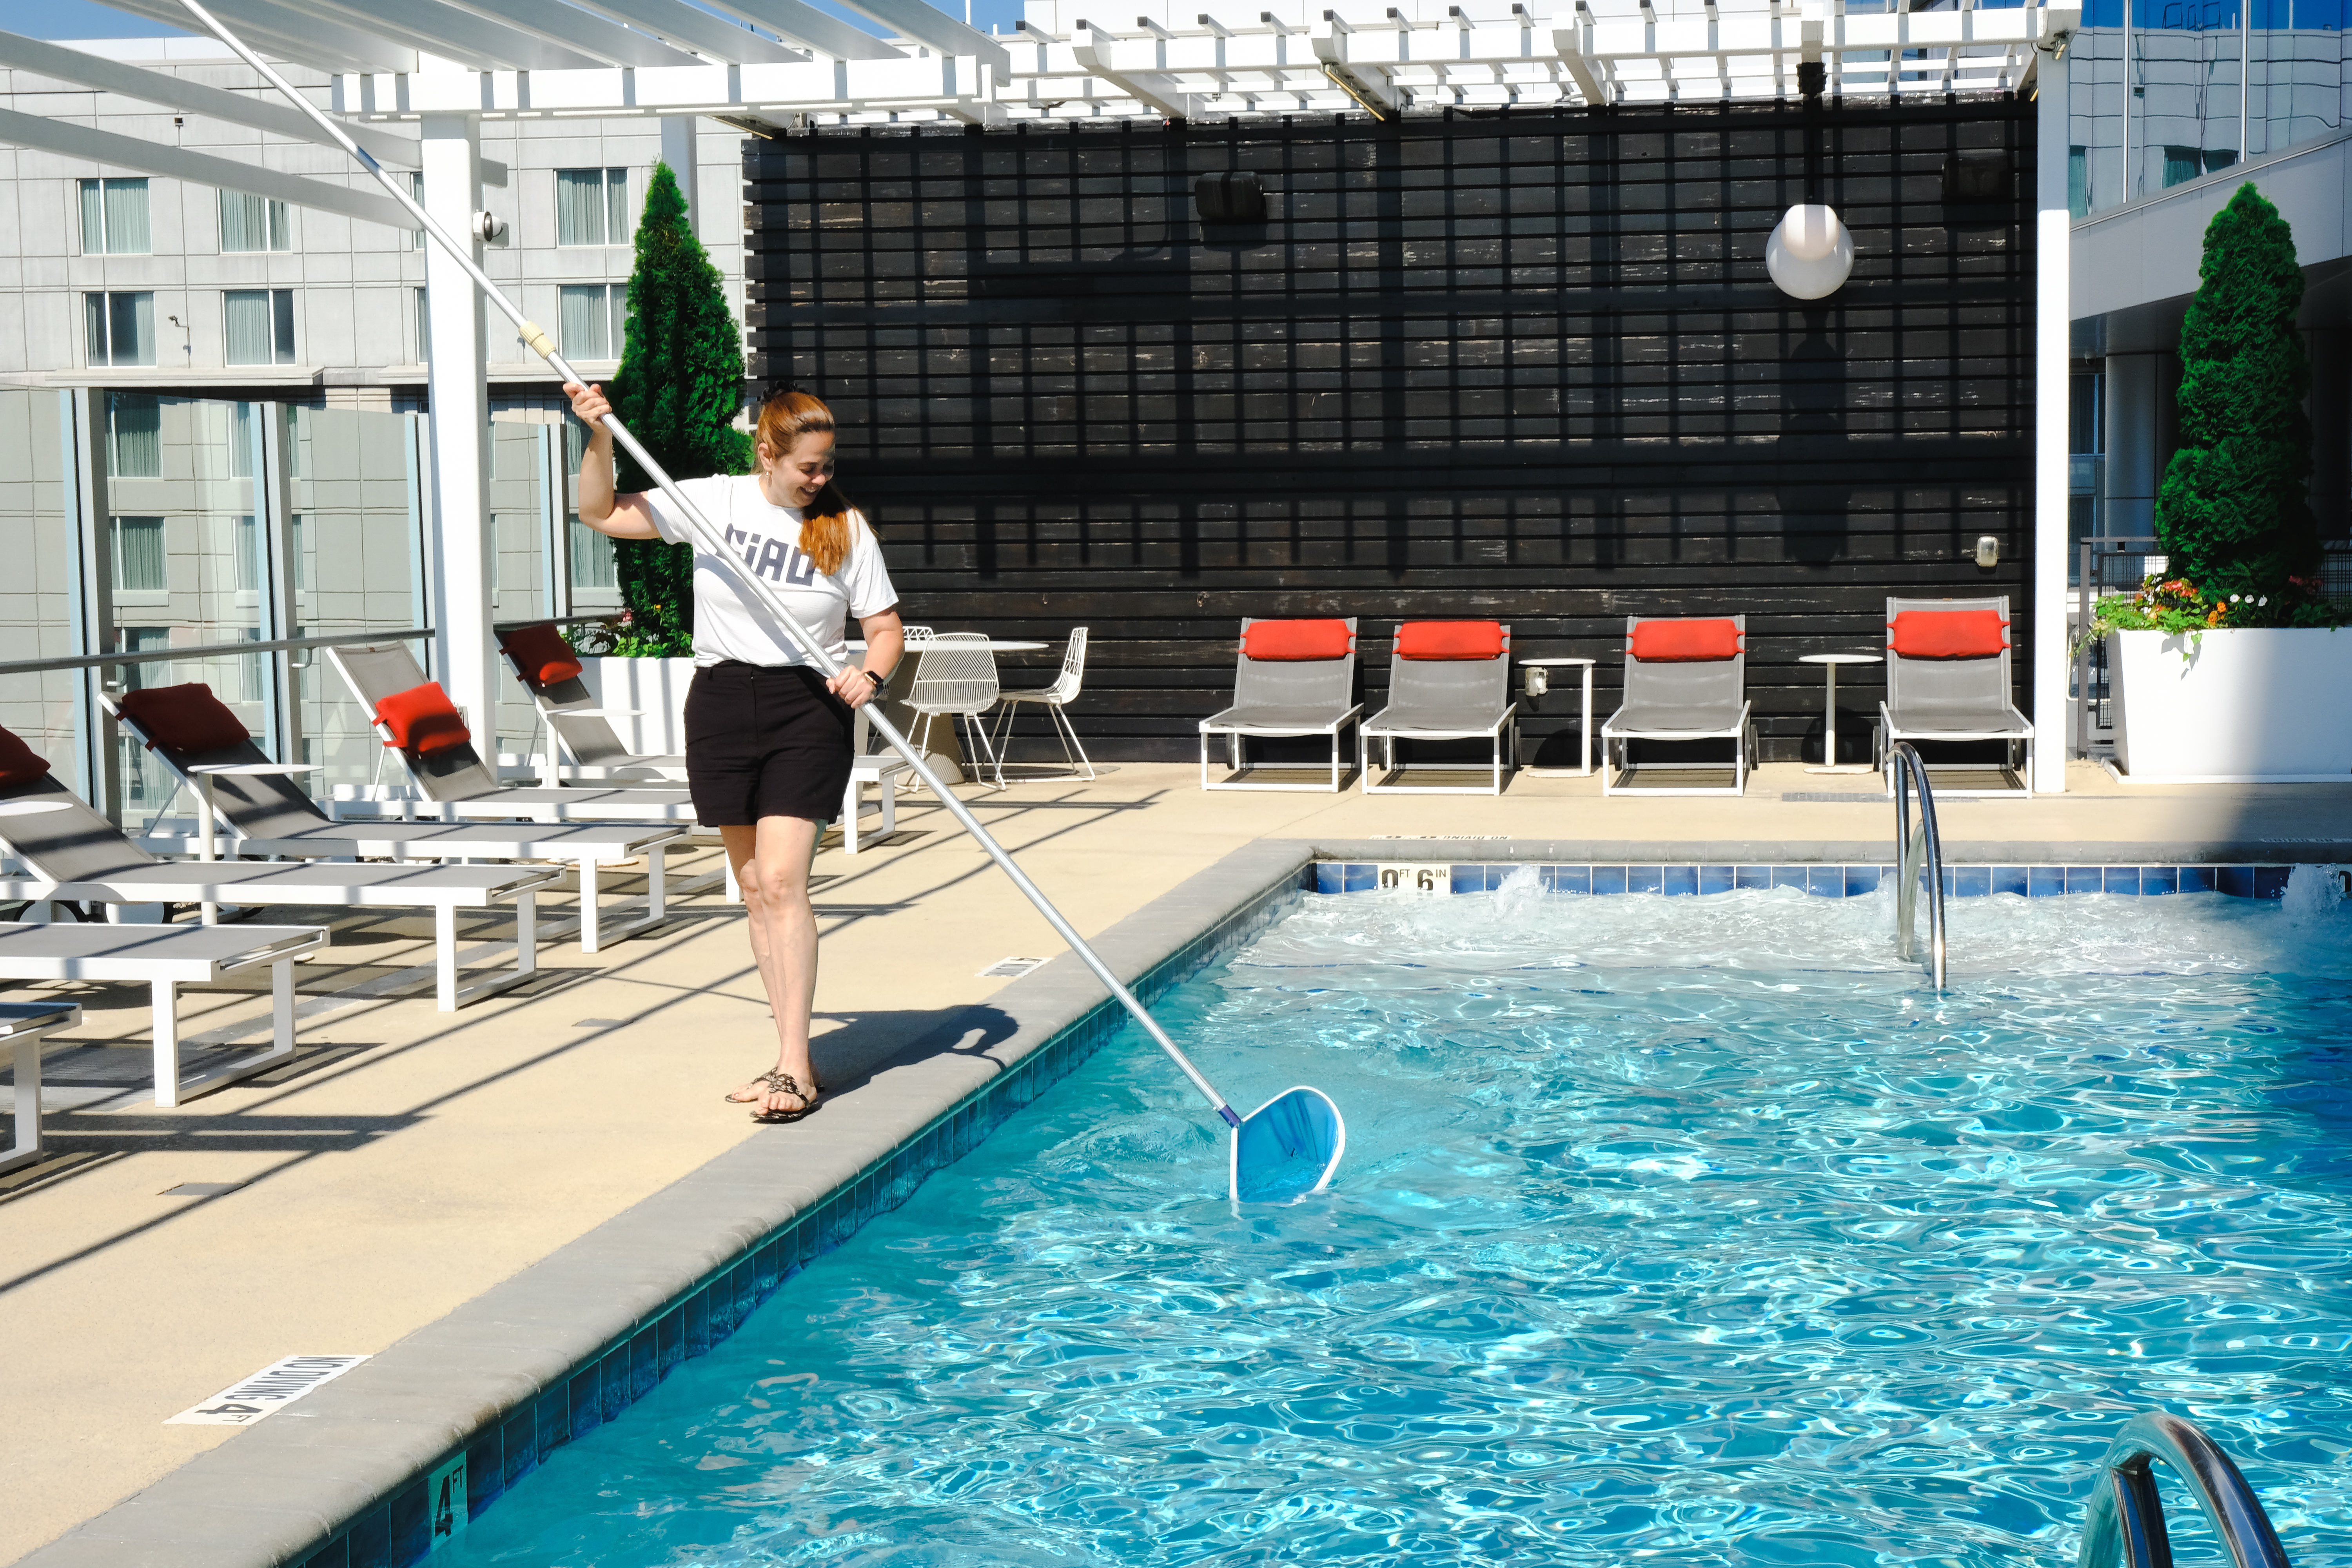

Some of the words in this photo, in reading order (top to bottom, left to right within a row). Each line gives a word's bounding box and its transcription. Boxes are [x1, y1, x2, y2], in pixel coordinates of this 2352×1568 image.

[1399, 869, 1410, 878] FT
[1417, 869, 1434, 890] 6
[1436, 869, 1446, 878] IN
[283, 1357, 356, 1368] NO
[224, 1371, 331, 1400] DIVING
[195, 1404, 264, 1414] 4
[435, 1474, 453, 1537] 4
[452, 1465, 463, 1494] FT
